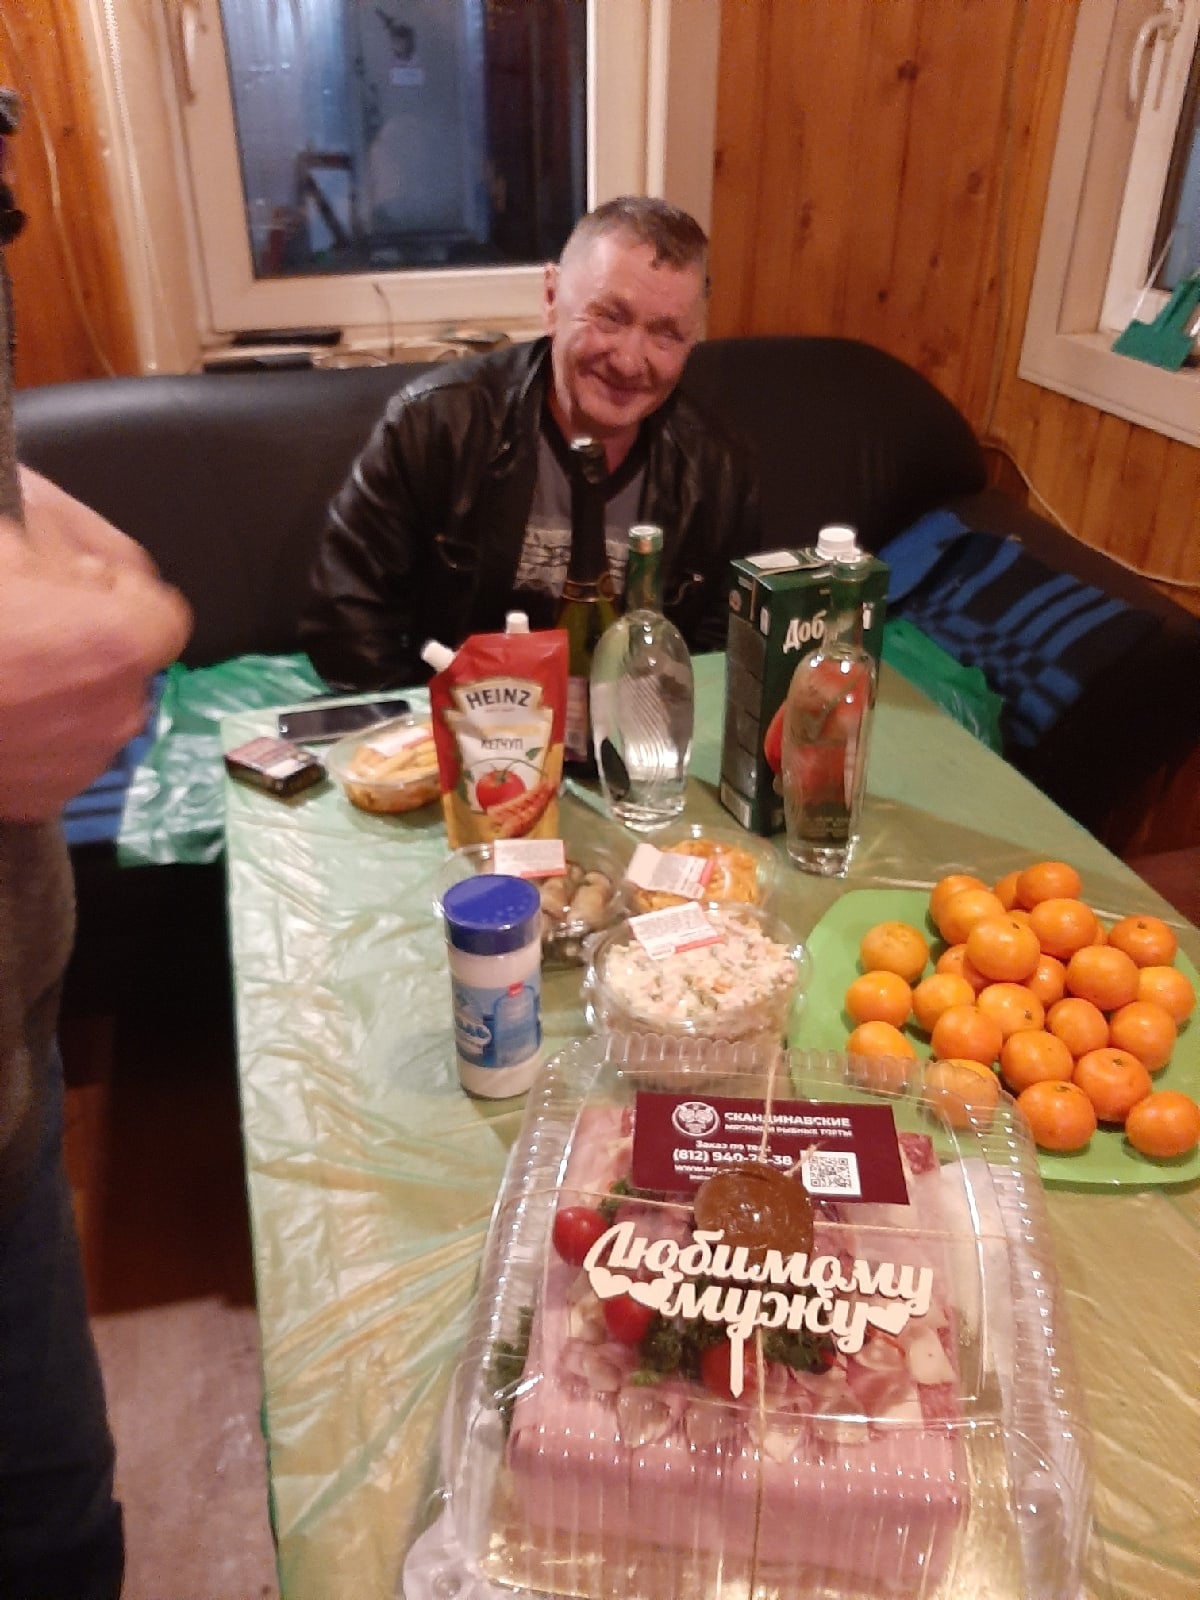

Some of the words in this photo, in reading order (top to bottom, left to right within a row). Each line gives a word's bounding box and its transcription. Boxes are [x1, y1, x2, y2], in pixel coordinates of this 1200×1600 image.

[466, 688, 531, 710] HEINZ
[481, 737, 524, 750] КЕТЧУП
[724, 1111, 851, 1127] СКАНДИНАВСКИЕ
[695, 1140, 728, 1149] Заказ
[729, 1143, 745, 1151] по
[672, 1149, 709, 1162] (812)
[583, 1221, 933, 1316] Любимому
[660, 1281, 868, 1353] мужу
